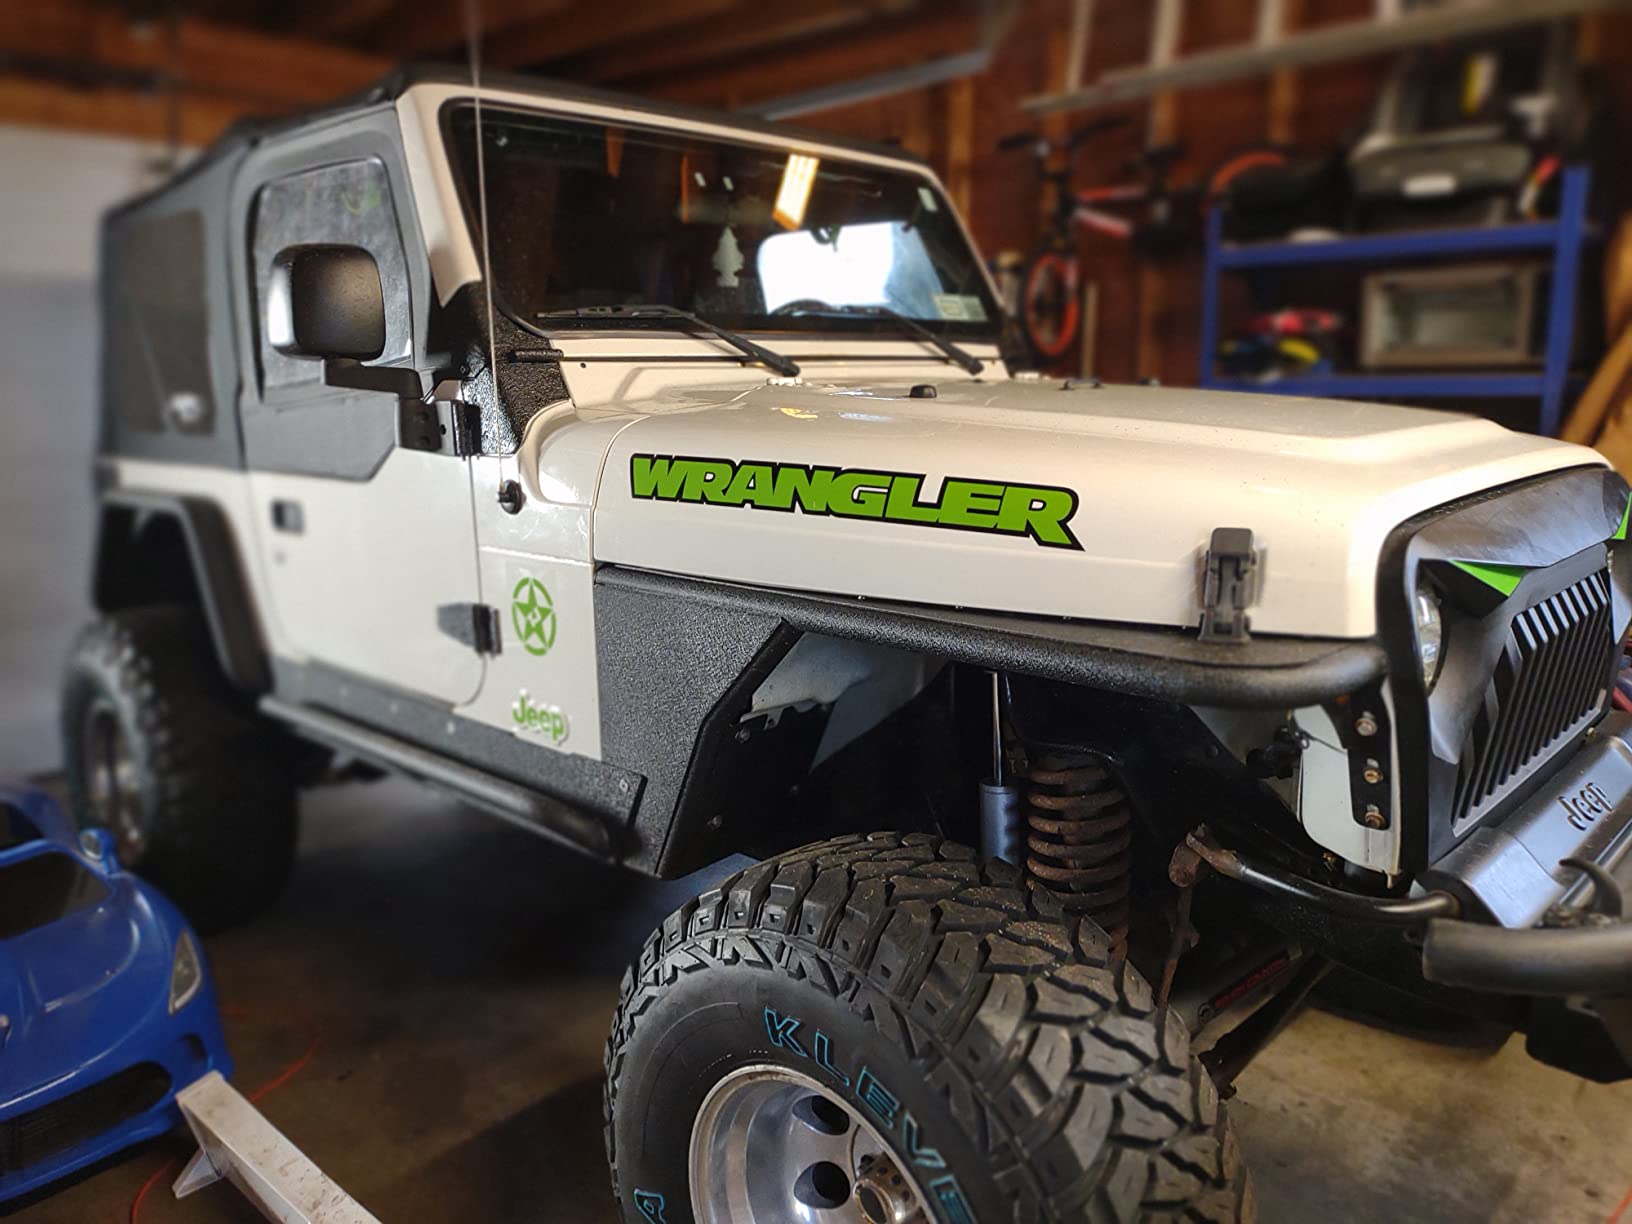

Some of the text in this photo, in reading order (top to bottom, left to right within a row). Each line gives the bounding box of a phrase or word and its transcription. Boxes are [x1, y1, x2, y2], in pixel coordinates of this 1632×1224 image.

[629, 453, 1085, 550] WRANGLER
[512, 692, 566, 742] Jeep
[1557, 782, 1613, 831] Jeep
